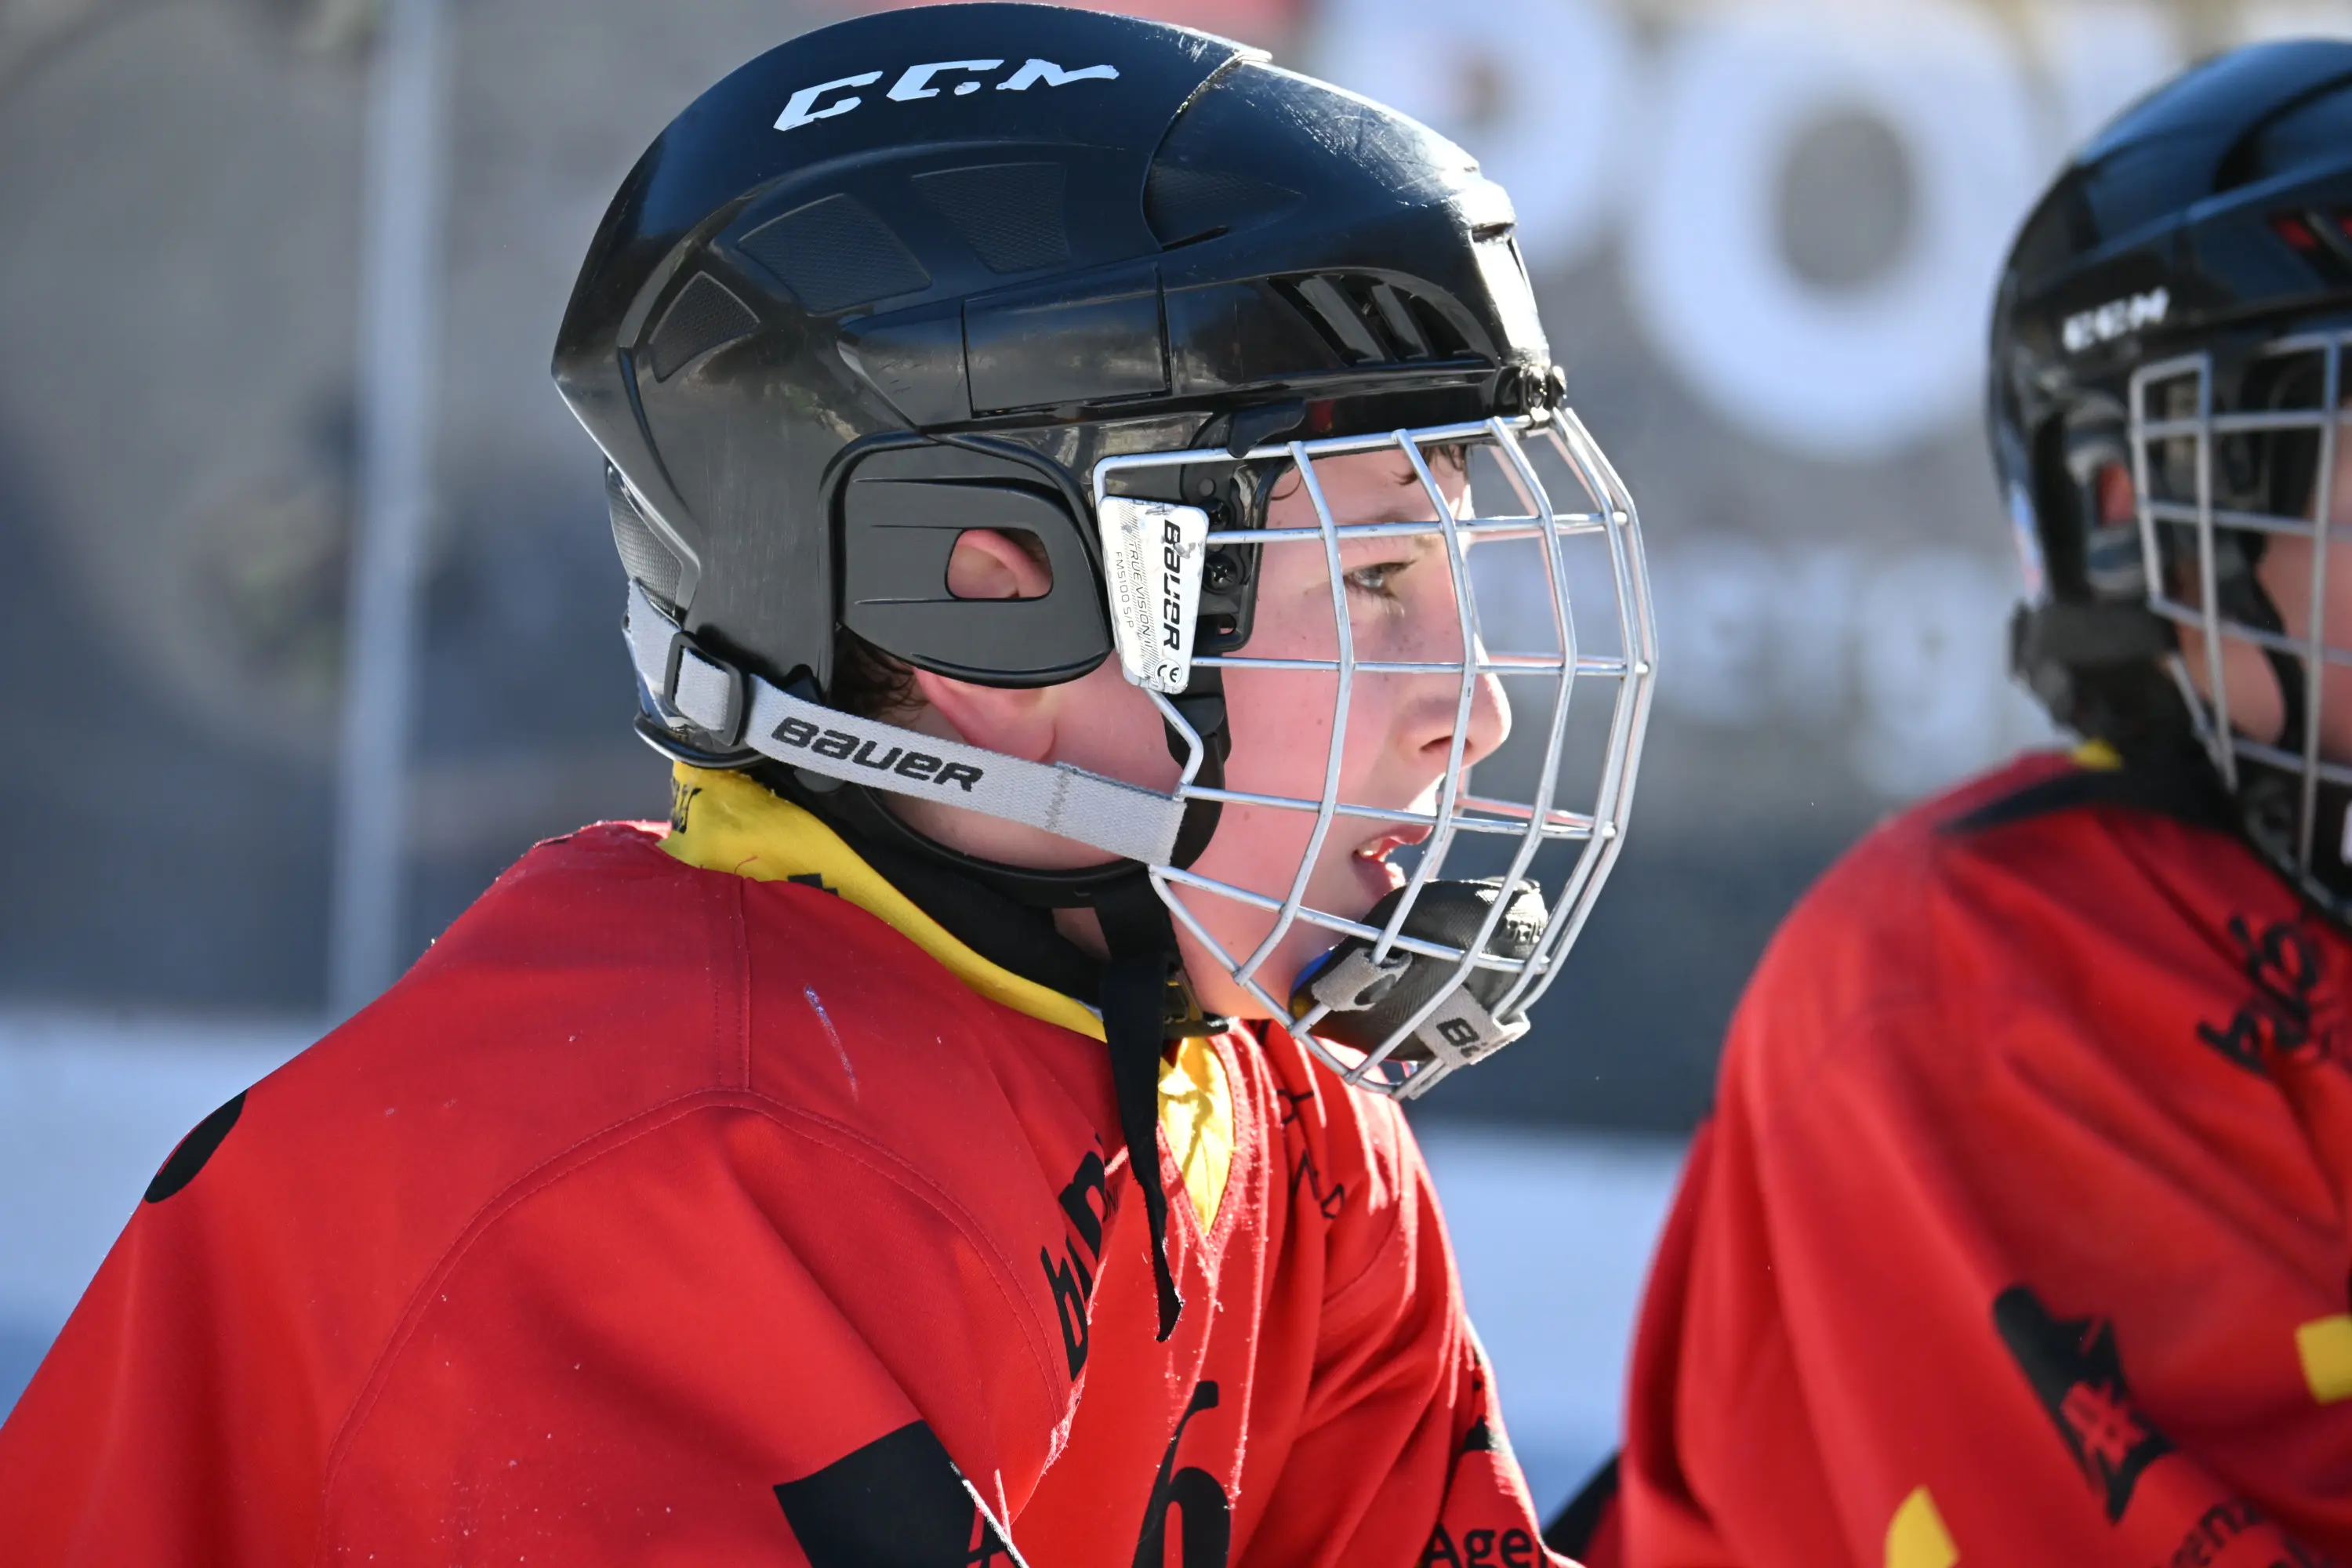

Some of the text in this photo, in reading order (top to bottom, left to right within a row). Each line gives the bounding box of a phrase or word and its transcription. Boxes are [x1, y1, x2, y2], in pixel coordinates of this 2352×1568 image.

[1123, 606, 1134, 628] S/P
[1128, 540, 1142, 581] TRUE
[1135, 586, 1151, 637] VISION
